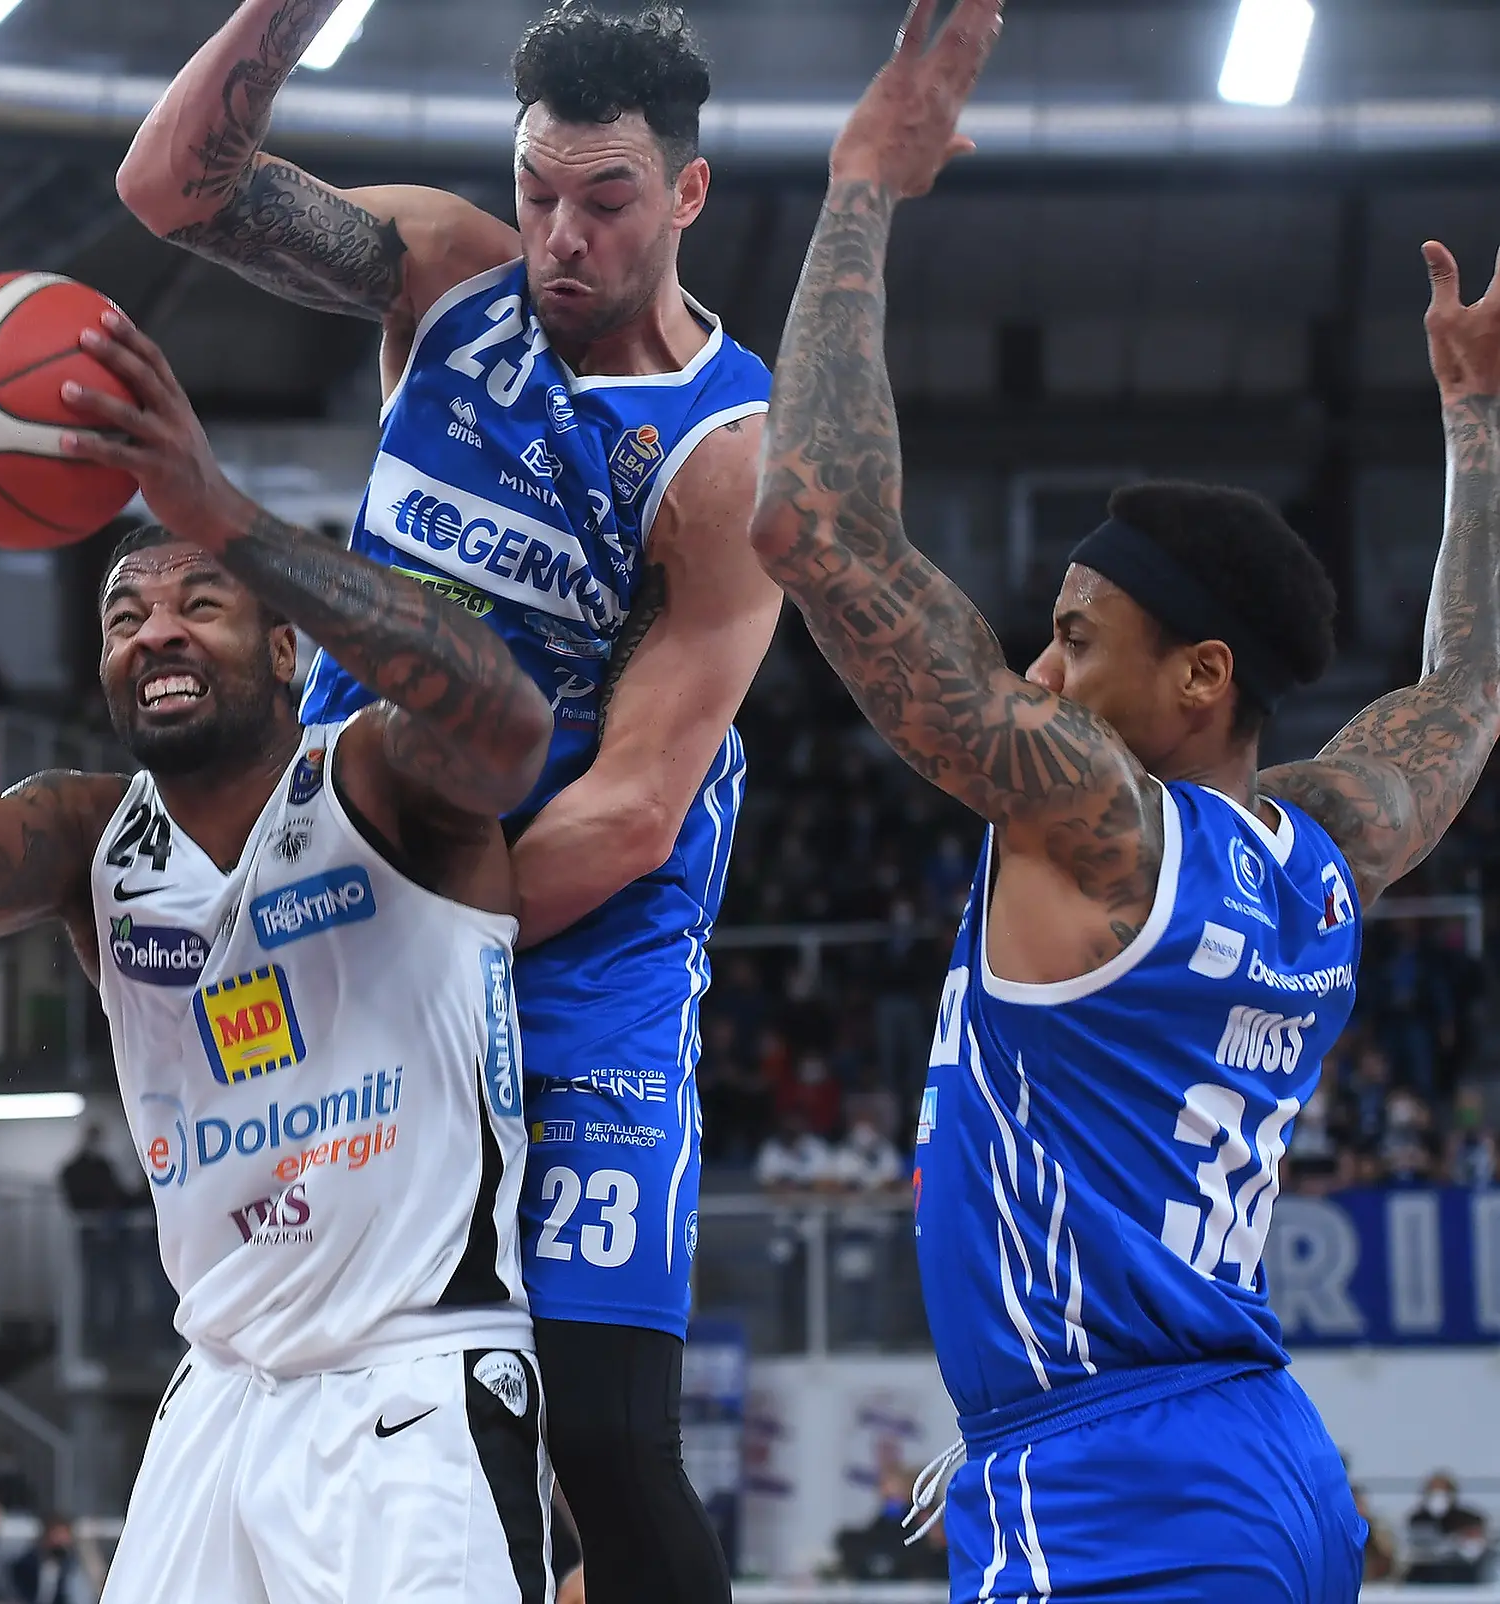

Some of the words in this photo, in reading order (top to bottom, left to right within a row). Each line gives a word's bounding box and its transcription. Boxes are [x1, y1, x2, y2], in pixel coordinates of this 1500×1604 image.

[445, 294, 551, 407] 23
[617, 448, 645, 476] LBA
[105, 804, 173, 873] 24
[257, 881, 365, 937] TRENTINO
[113, 936, 205, 970] Melinda
[215, 1000, 283, 1048] MD
[1216, 1004, 1316, 1075] MOSS
[590, 1068, 666, 1079] METROLOGIA
[195, 1065, 405, 1167] Dolomiti
[584, 1122, 667, 1139] METALLURGICA
[584, 1131, 609, 1142] SAN
[613, 1134, 656, 1147] MARCO
[273, 1121, 397, 1182] energia
[1161, 1082, 1300, 1292] 34
[536, 1166, 639, 1267] 23
